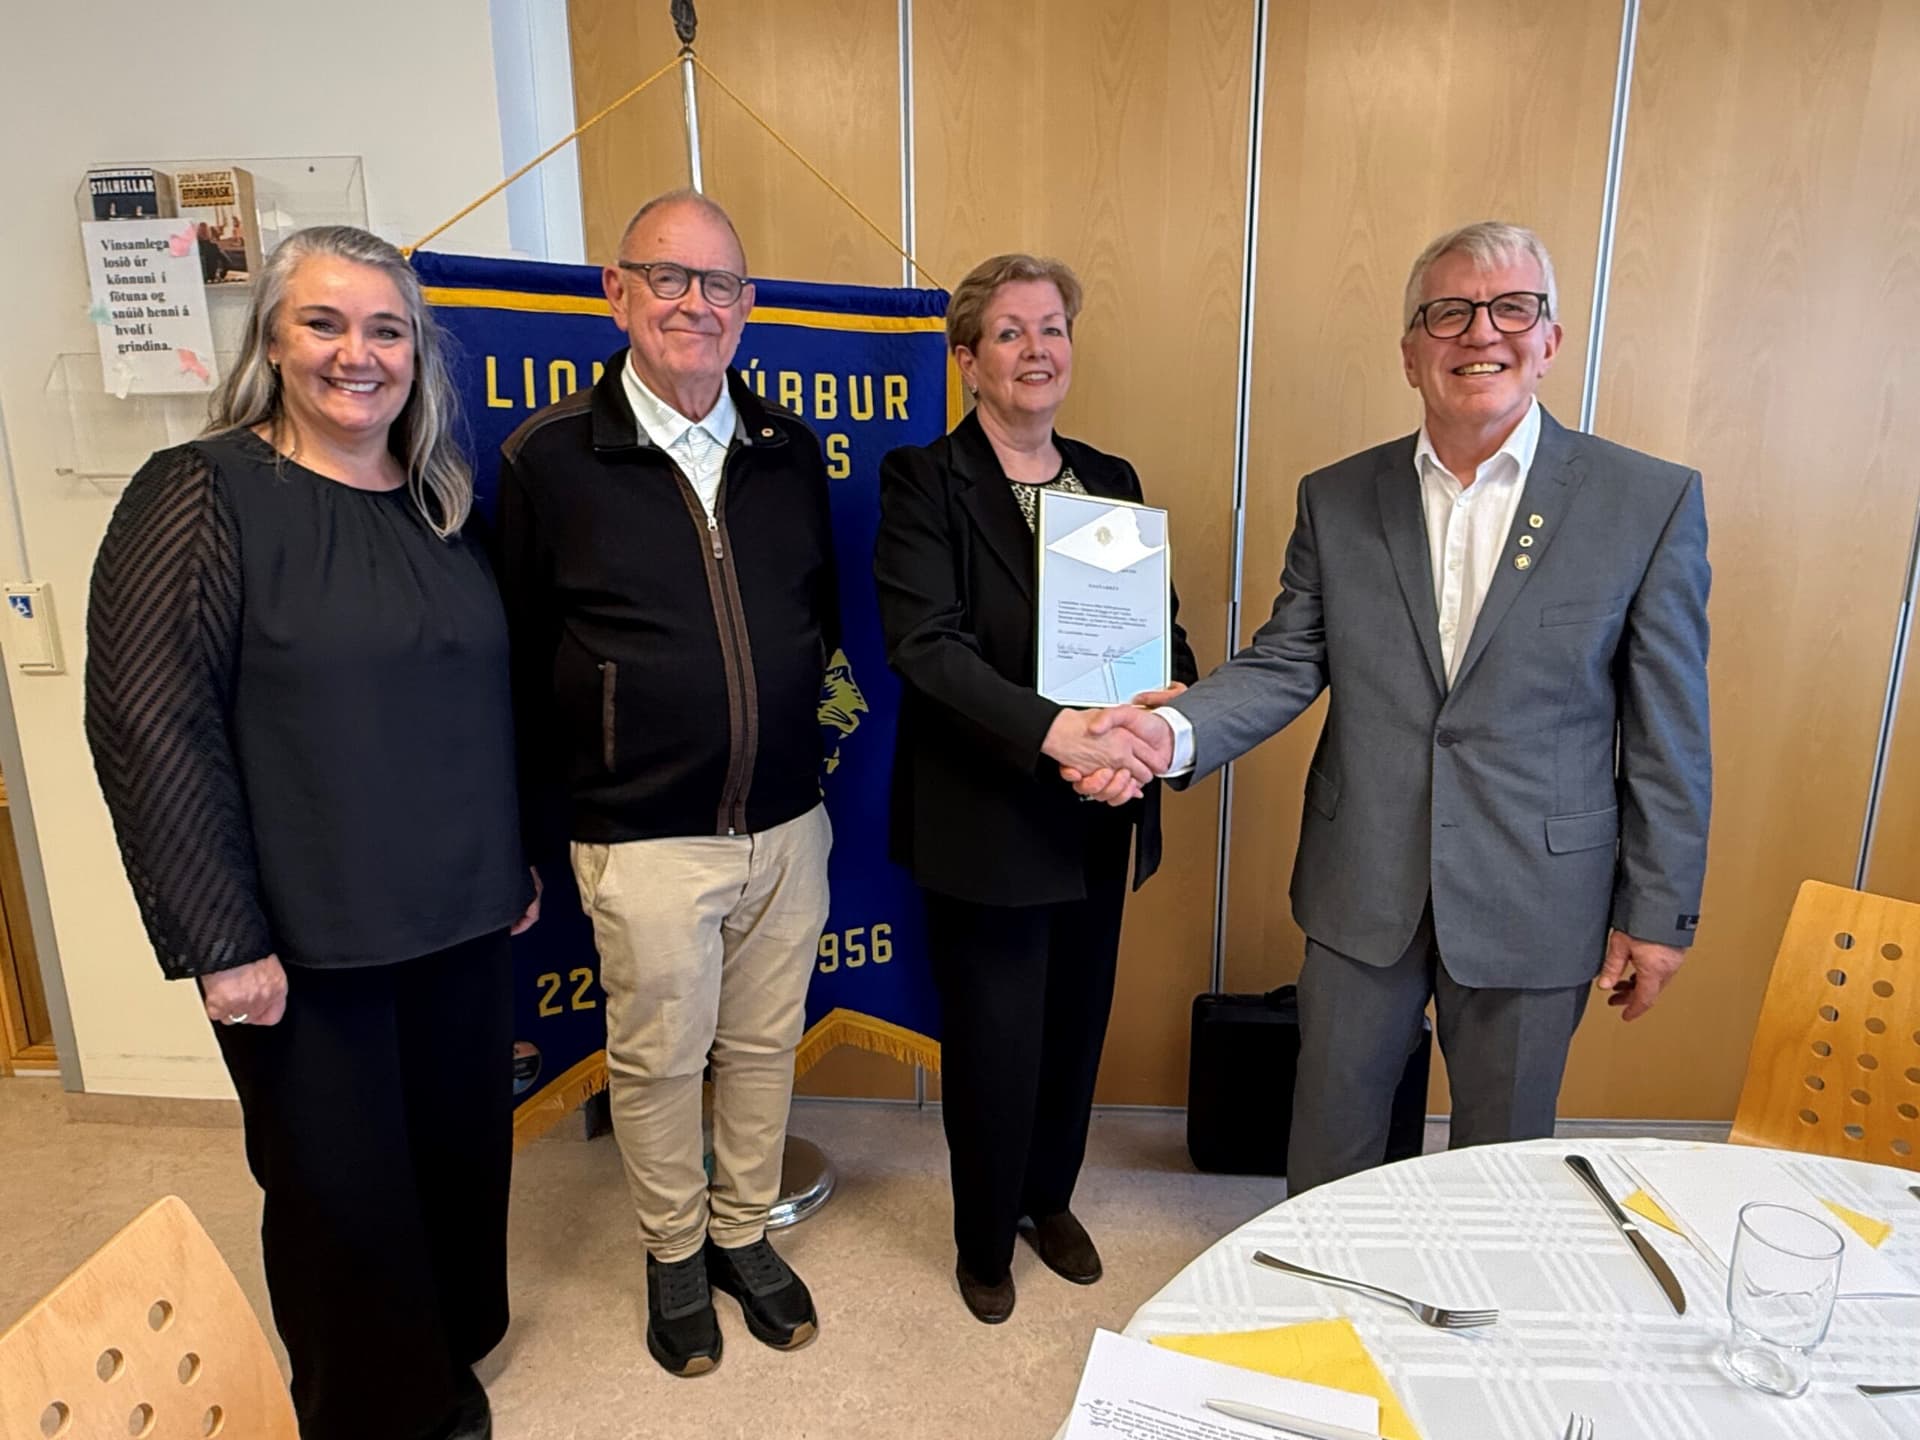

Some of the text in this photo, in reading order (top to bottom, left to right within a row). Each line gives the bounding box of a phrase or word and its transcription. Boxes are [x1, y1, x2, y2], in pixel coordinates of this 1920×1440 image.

[101, 238, 170, 252] Vinsamlega
[103, 255, 148, 269] losið úr
[106, 271, 167, 285] könnuni í
[109, 290, 166, 303] fötuna og
[112, 304, 190, 319] snúið henni á
[115, 323, 146, 336] hvolf
[118, 340, 172, 355] grindina.
[486, 355, 605, 409] LIO
